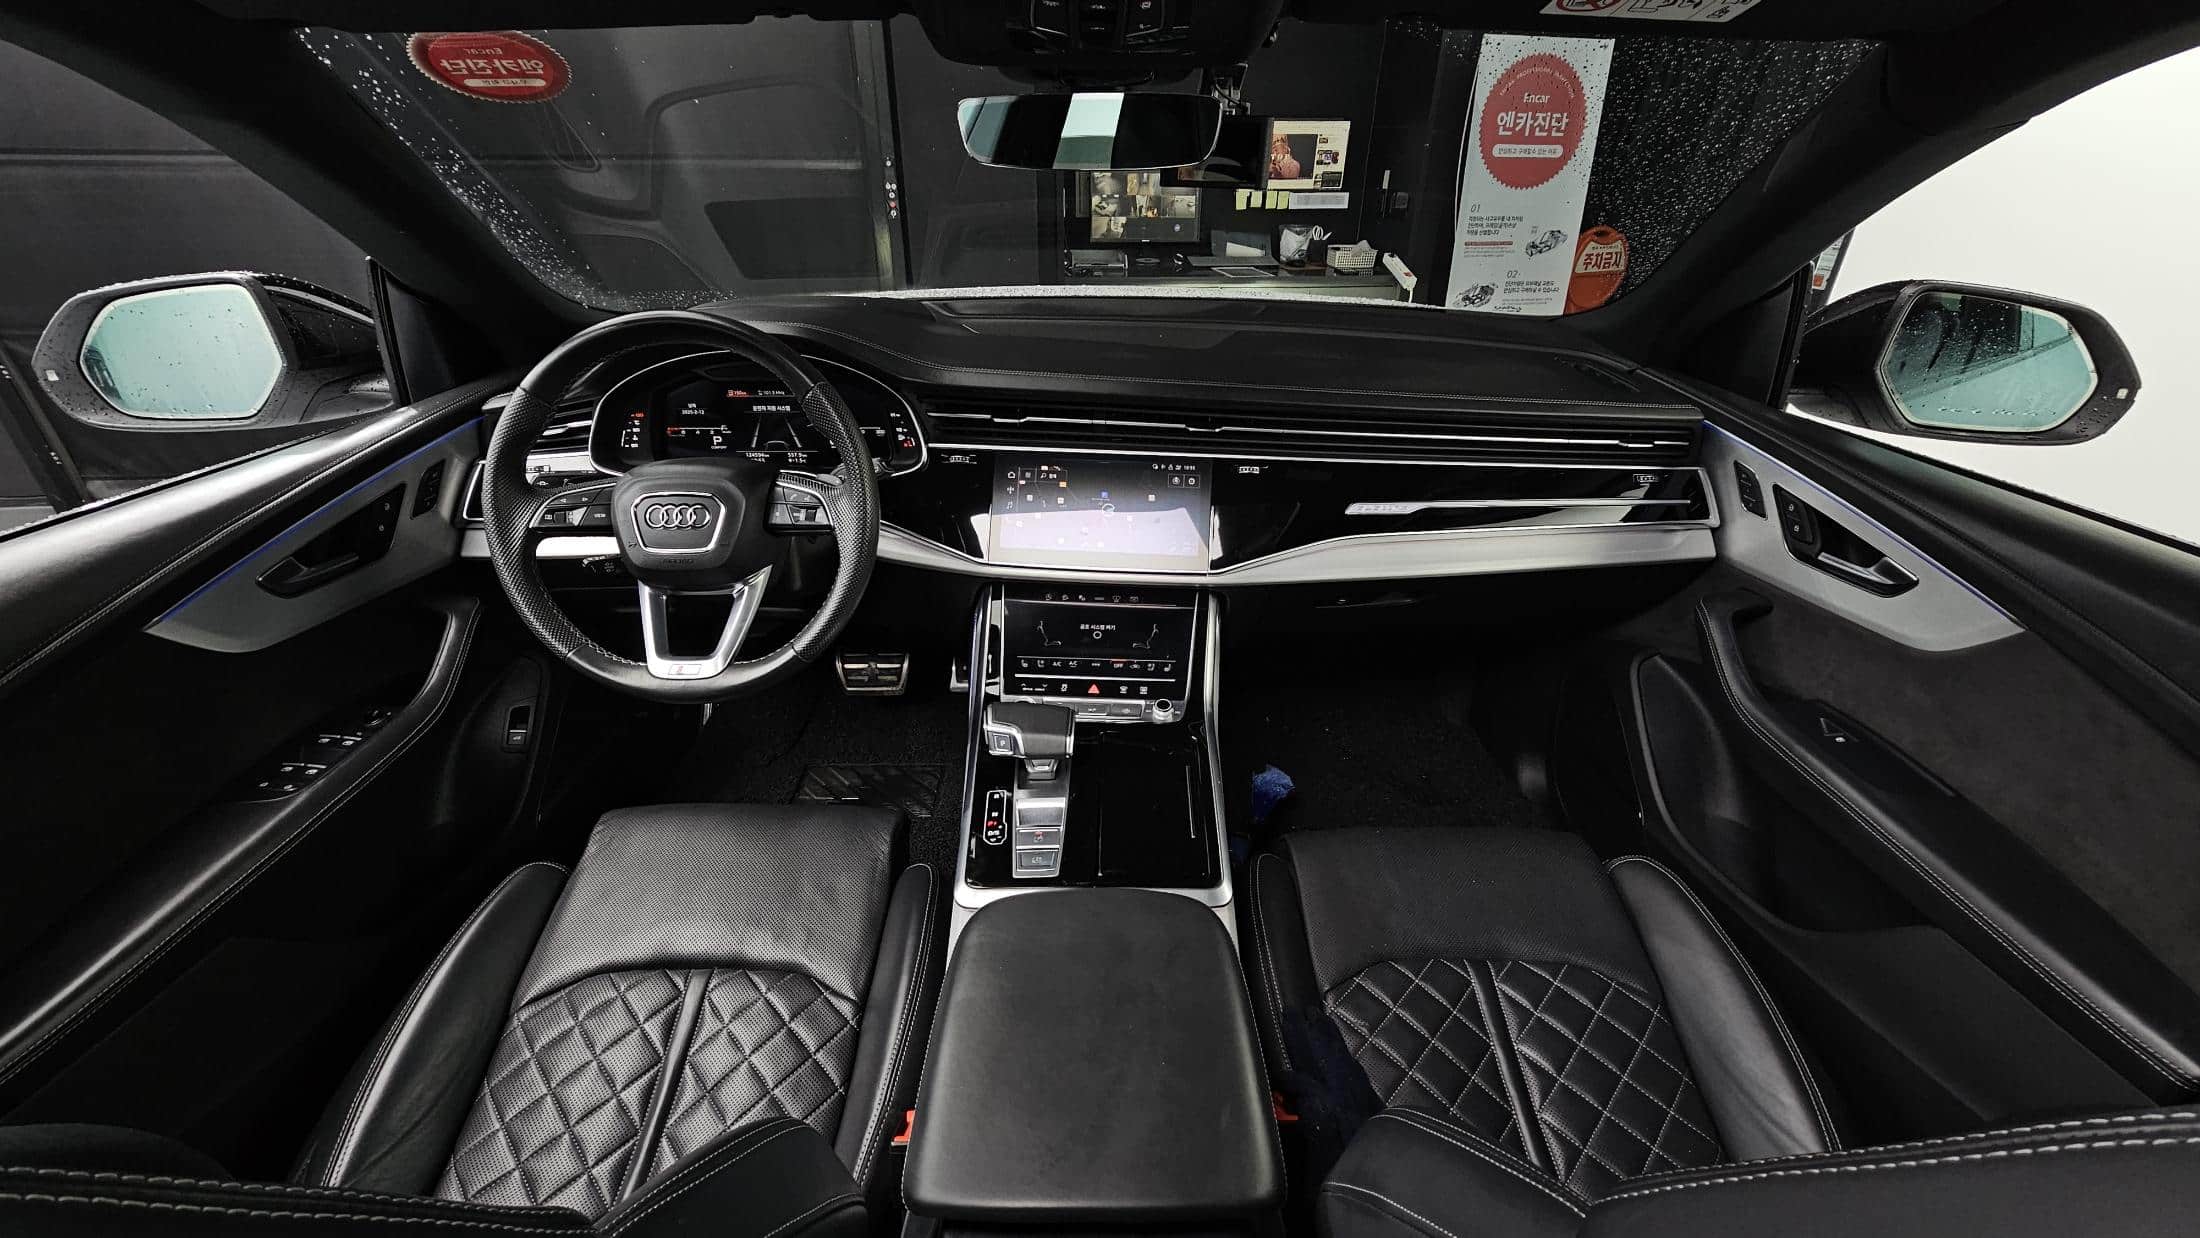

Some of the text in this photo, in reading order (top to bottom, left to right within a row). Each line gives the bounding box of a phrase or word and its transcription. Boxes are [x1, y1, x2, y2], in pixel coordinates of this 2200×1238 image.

[1523, 92, 1550, 103] Encar
[1497, 112, 1569, 137] 엔카진단
[1470, 204, 1481, 213] 01
[1583, 251, 1622, 271] 주차금지
[1506, 270, 1519, 279] 02
[713, 436, 723, 445] P
